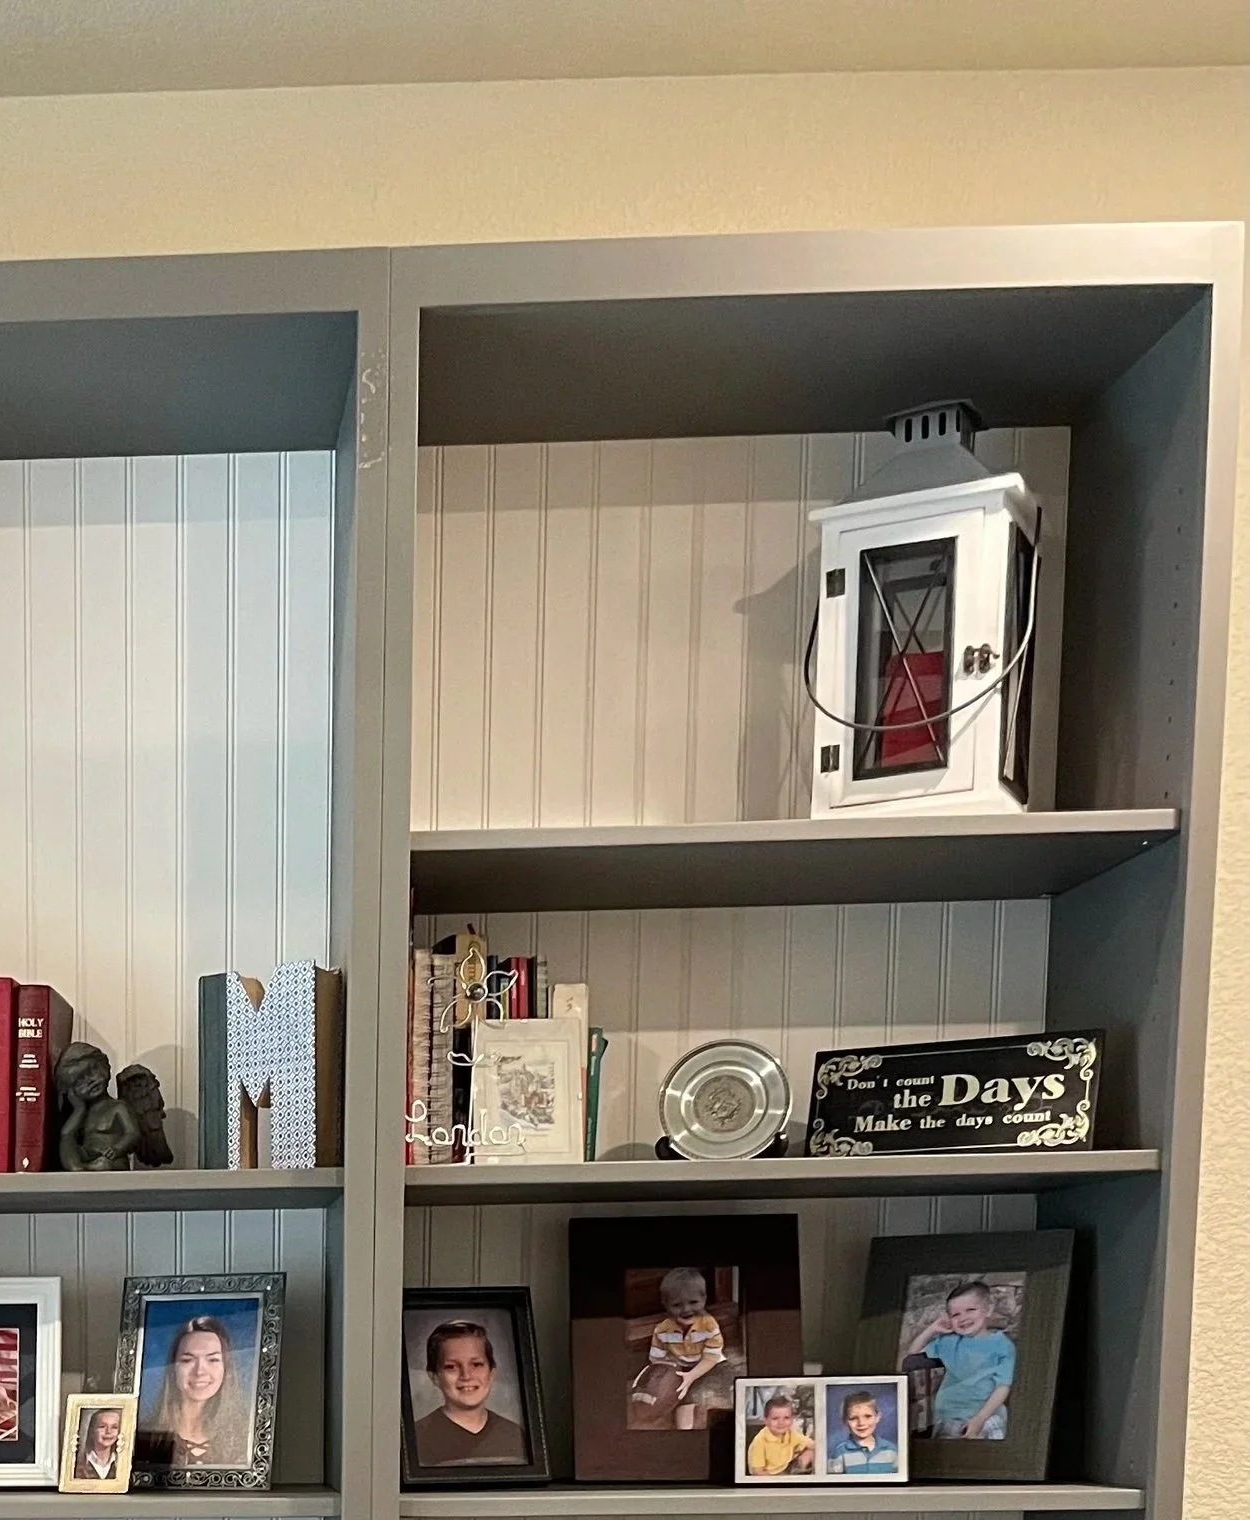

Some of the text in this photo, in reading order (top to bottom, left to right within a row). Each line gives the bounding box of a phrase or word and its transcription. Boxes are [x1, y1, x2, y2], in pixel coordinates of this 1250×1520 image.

[18, 1017, 44, 1028] HOLY
[18, 1028, 43, 1038] BIBLE
[847, 1075, 936, 1091] Don't count
[893, 1074, 1066, 1111] the Days
[405, 1099, 527, 1147] London
[853, 1110, 1051, 1134] Make the days count
